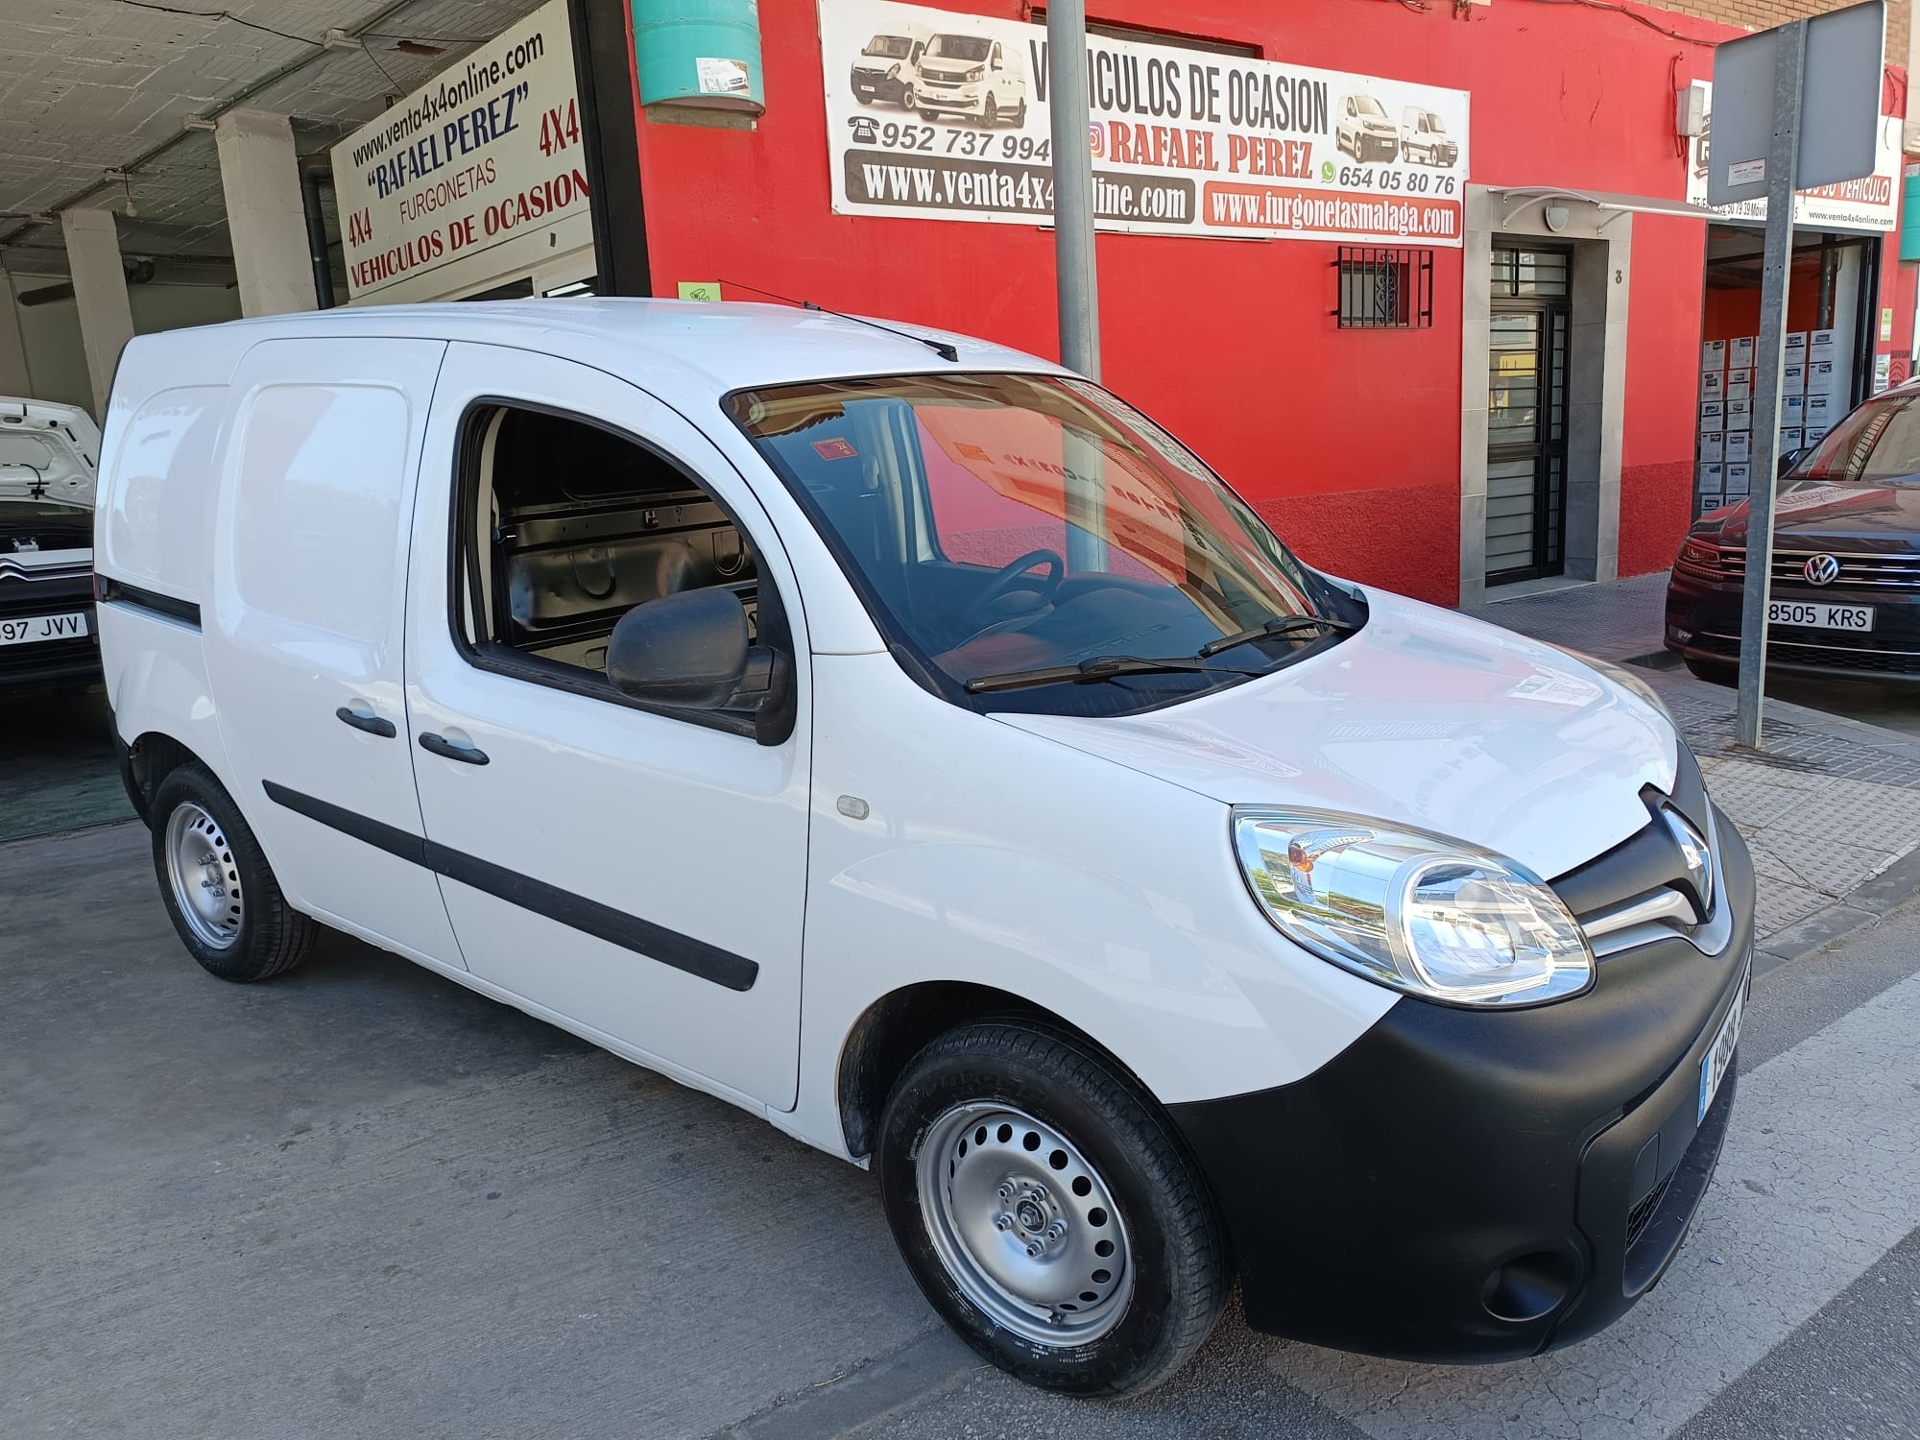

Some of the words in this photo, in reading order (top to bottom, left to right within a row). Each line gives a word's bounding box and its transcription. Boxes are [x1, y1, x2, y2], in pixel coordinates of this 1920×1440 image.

[353, 32, 544, 168] www.venta4x4online.com
[1029, 39, 1182, 119] VICULOS
[1188, 63, 1221, 124] DE
[1228, 68, 1328, 135] OCASION
[539, 98, 579, 158] 4X4
[881, 122, 935, 151] 952
[945, 128, 994, 157] 737
[1001, 134, 1050, 162] 994
[1108, 120, 1219, 171] RAFAEL
[1228, 134, 1313, 179] PEREZ
[400, 157, 496, 225] FURGONETAS
[1339, 167, 1373, 188] 654
[1379, 171, 1402, 190] 05
[1406, 173, 1429, 193] 80
[1434, 175, 1455, 195] 76
[348, 206, 373, 248] 4X4
[350, 230, 443, 289] VEHICULOS
[449, 214, 478, 252] DE
[484, 168, 590, 236] OCASION
[1212, 191, 1454, 236] www.furgonetasmalaga.com
[0, 621, 29, 641] 97
[40, 615, 78, 637] JVV
[1768, 604, 1816, 624] 8505
[1827, 608, 1867, 628] KRS
